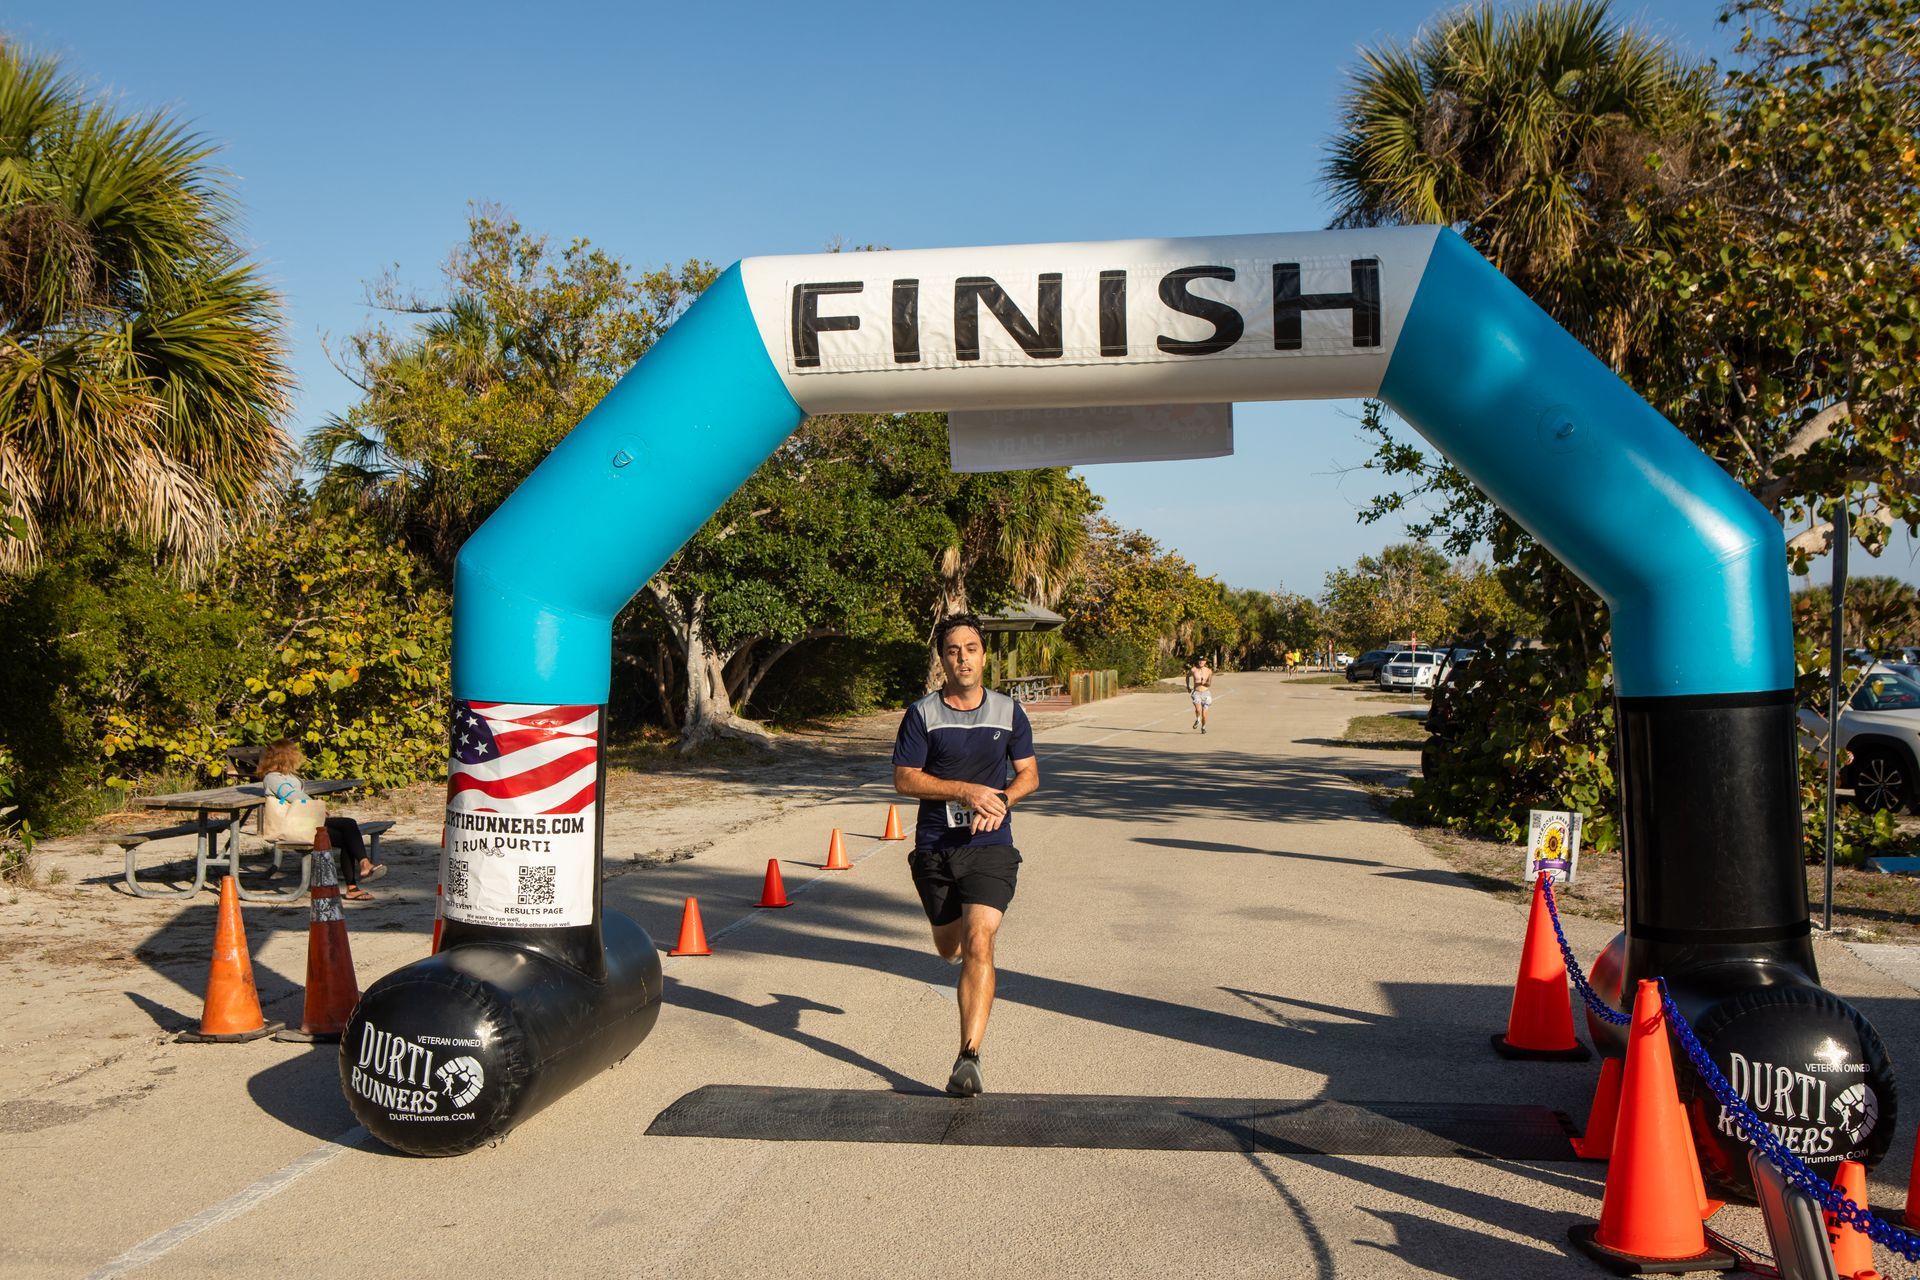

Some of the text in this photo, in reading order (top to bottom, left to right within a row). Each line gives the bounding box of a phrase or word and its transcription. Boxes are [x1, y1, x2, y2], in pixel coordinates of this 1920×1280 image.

[791, 257, 1381, 368] FINISH
[954, 812, 977, 825] 91
[455, 836, 551, 852] I RUN DURTI
[456, 902, 472, 910] EVENT
[417, 1035, 481, 1048] VETERAN OWNED
[359, 1021, 433, 1089] DURTI
[1805, 1063, 1871, 1073] VETERAN OWNED
[352, 1066, 438, 1114] RUNNERS
[1730, 1052, 1827, 1125] DURTI
